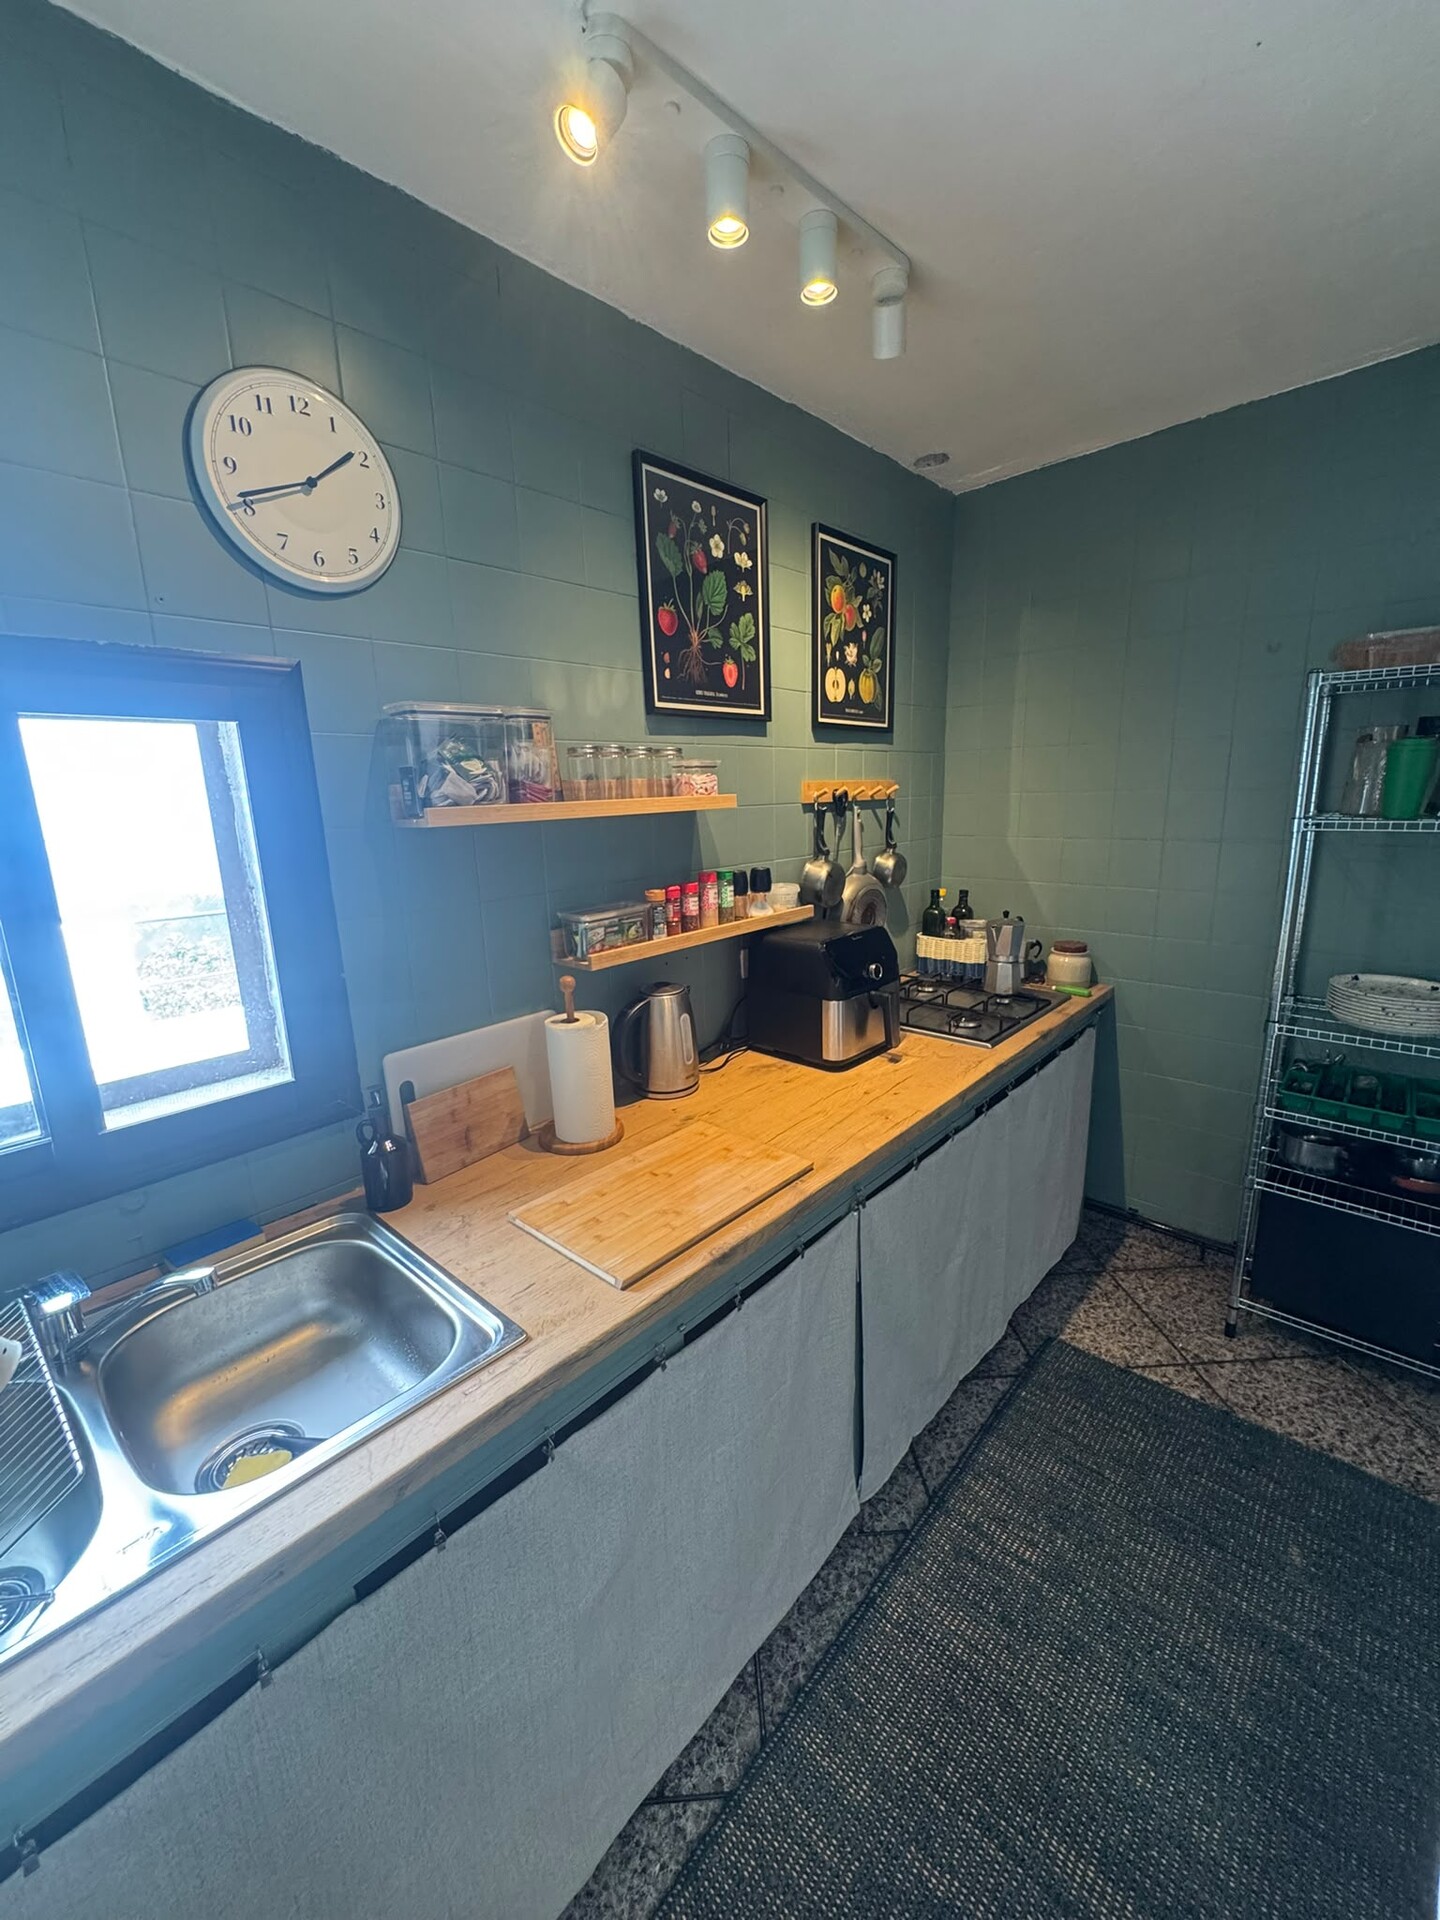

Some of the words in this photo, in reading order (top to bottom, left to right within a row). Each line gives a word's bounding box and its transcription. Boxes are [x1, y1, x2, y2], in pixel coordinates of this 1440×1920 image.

[256, 394, 275, 415] 11
[290, 395, 311, 417] 12
[230, 414, 252, 437] 10
[330, 417, 337, 433] 1
[223, 456, 237, 474] 9
[358, 452, 370, 468] 2
[243, 499, 256, 517] 8
[375, 493, 385, 509] 3
[277, 533, 288, 550] 7
[369, 528, 379, 543] 4
[313, 551, 325, 567] 6
[349, 548, 359, 565] 5
